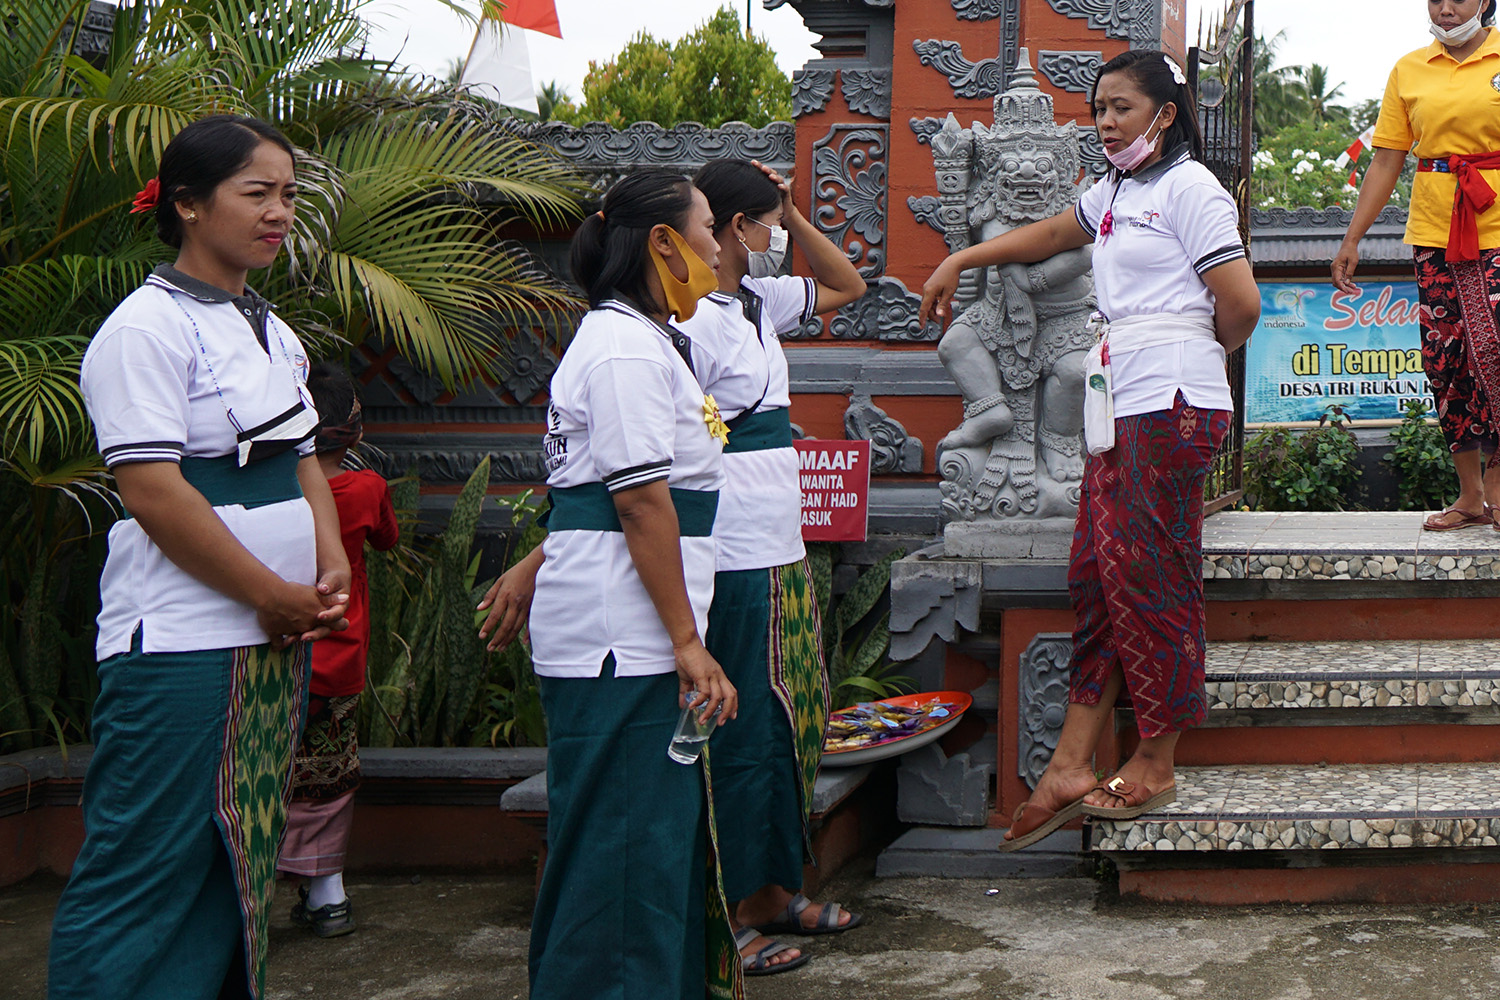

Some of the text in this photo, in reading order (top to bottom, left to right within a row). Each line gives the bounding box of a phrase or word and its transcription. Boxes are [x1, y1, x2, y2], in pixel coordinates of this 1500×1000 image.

[1324, 285, 1420, 331] Sela
[1263, 319, 1306, 329] indonesia
[1292, 343, 1320, 376] di
[1326, 343, 1424, 380] Tempa
[1280, 382, 1323, 397] DESA
[1327, 382, 1355, 396] TRI
[1360, 380, 1418, 395] RUKUN
[799, 450, 860, 471] MAAF
[801, 474, 844, 490] WANITA
[800, 492, 822, 508] GAN
[830, 492, 858, 508] HAID
[800, 510, 833, 526] ASUK
